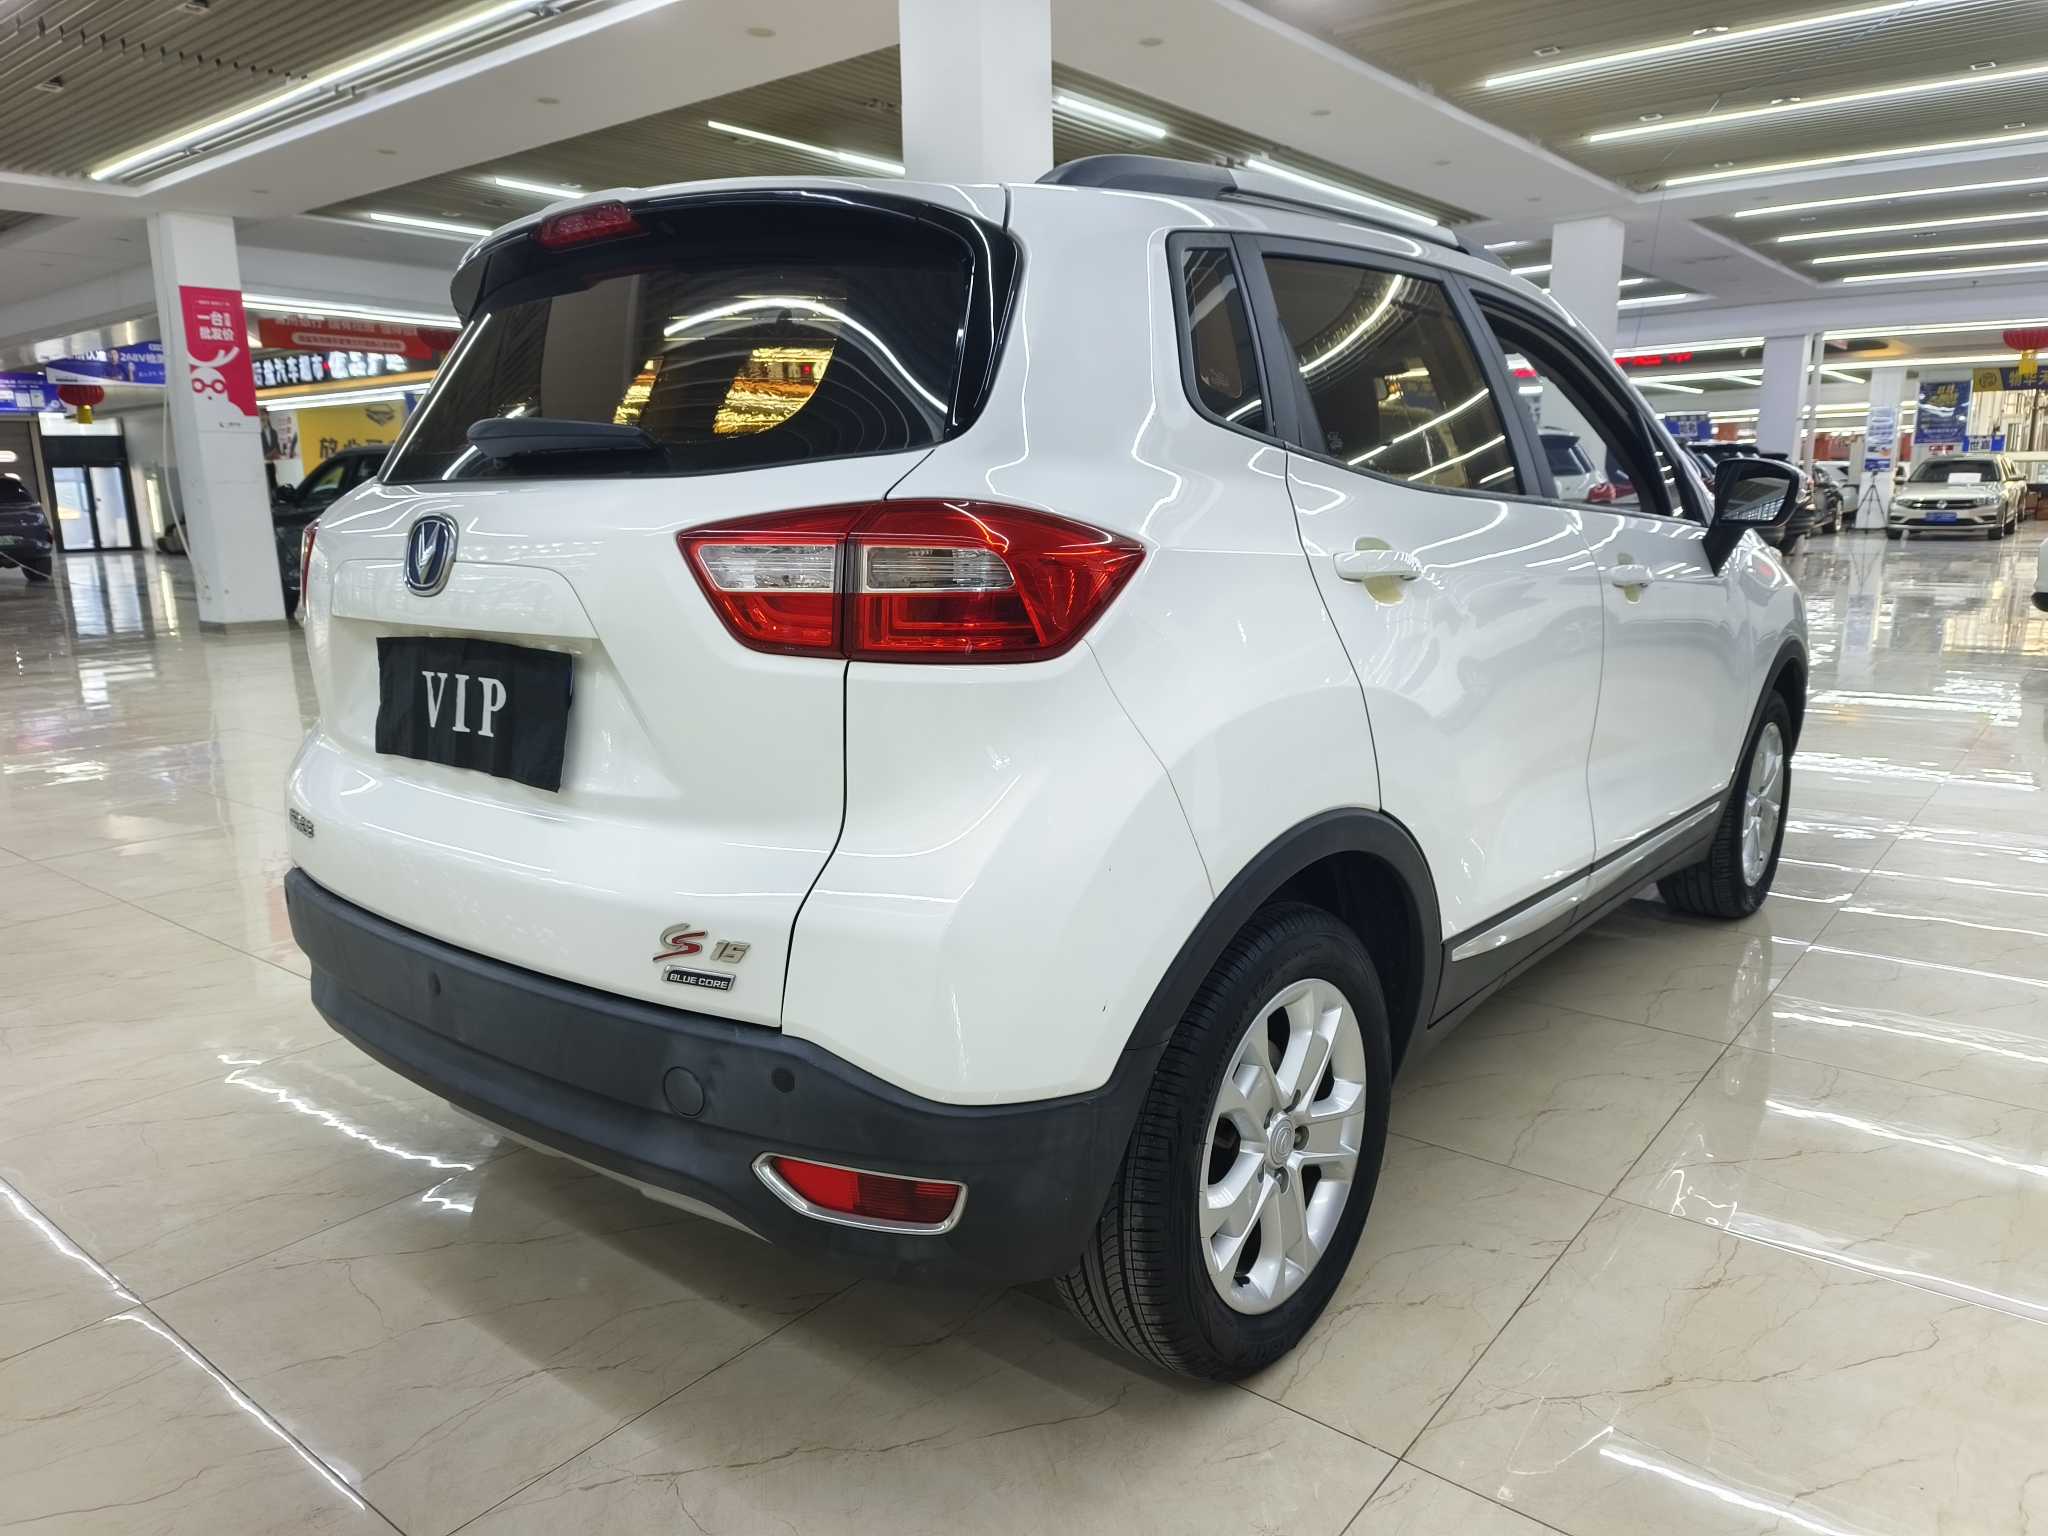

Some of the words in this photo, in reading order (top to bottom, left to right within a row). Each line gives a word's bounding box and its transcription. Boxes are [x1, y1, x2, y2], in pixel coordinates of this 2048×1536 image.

[199, 327, 234, 341] 批发价
[421, 670, 507, 738] VIP
[669, 973, 698, 985] BLUE
[698, 978, 729, 990] CORE
